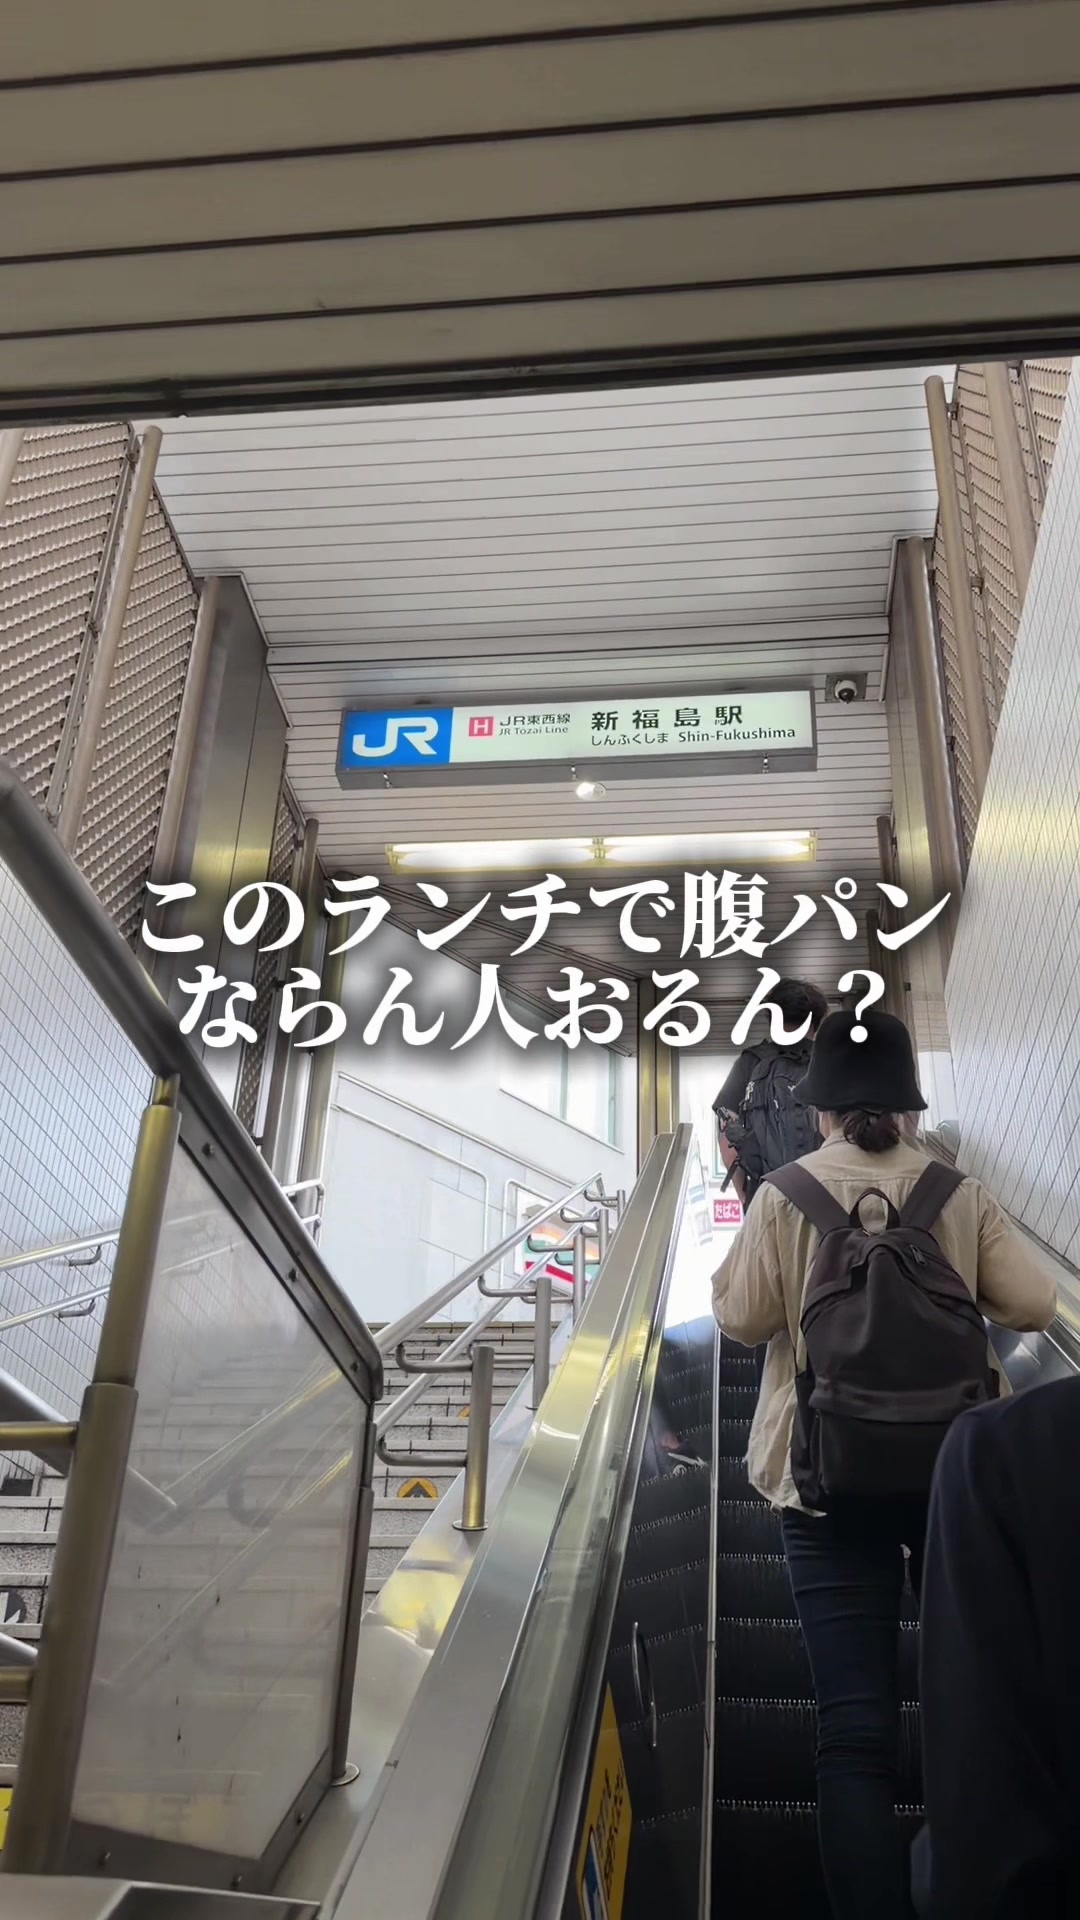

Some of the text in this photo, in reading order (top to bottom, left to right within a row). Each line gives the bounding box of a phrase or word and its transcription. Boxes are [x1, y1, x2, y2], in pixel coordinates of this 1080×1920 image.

[471, 718, 490, 736] H
[499, 713, 571, 726] JR東西線
[591, 705, 743, 732] 新福島駅
[352, 716, 439, 757] JR
[499, 725, 569, 736] JR Tozai Line
[591, 727, 796, 747] しんふくしま Shin-Fukushima
[714, 1202, 740, 1219] たばこ
